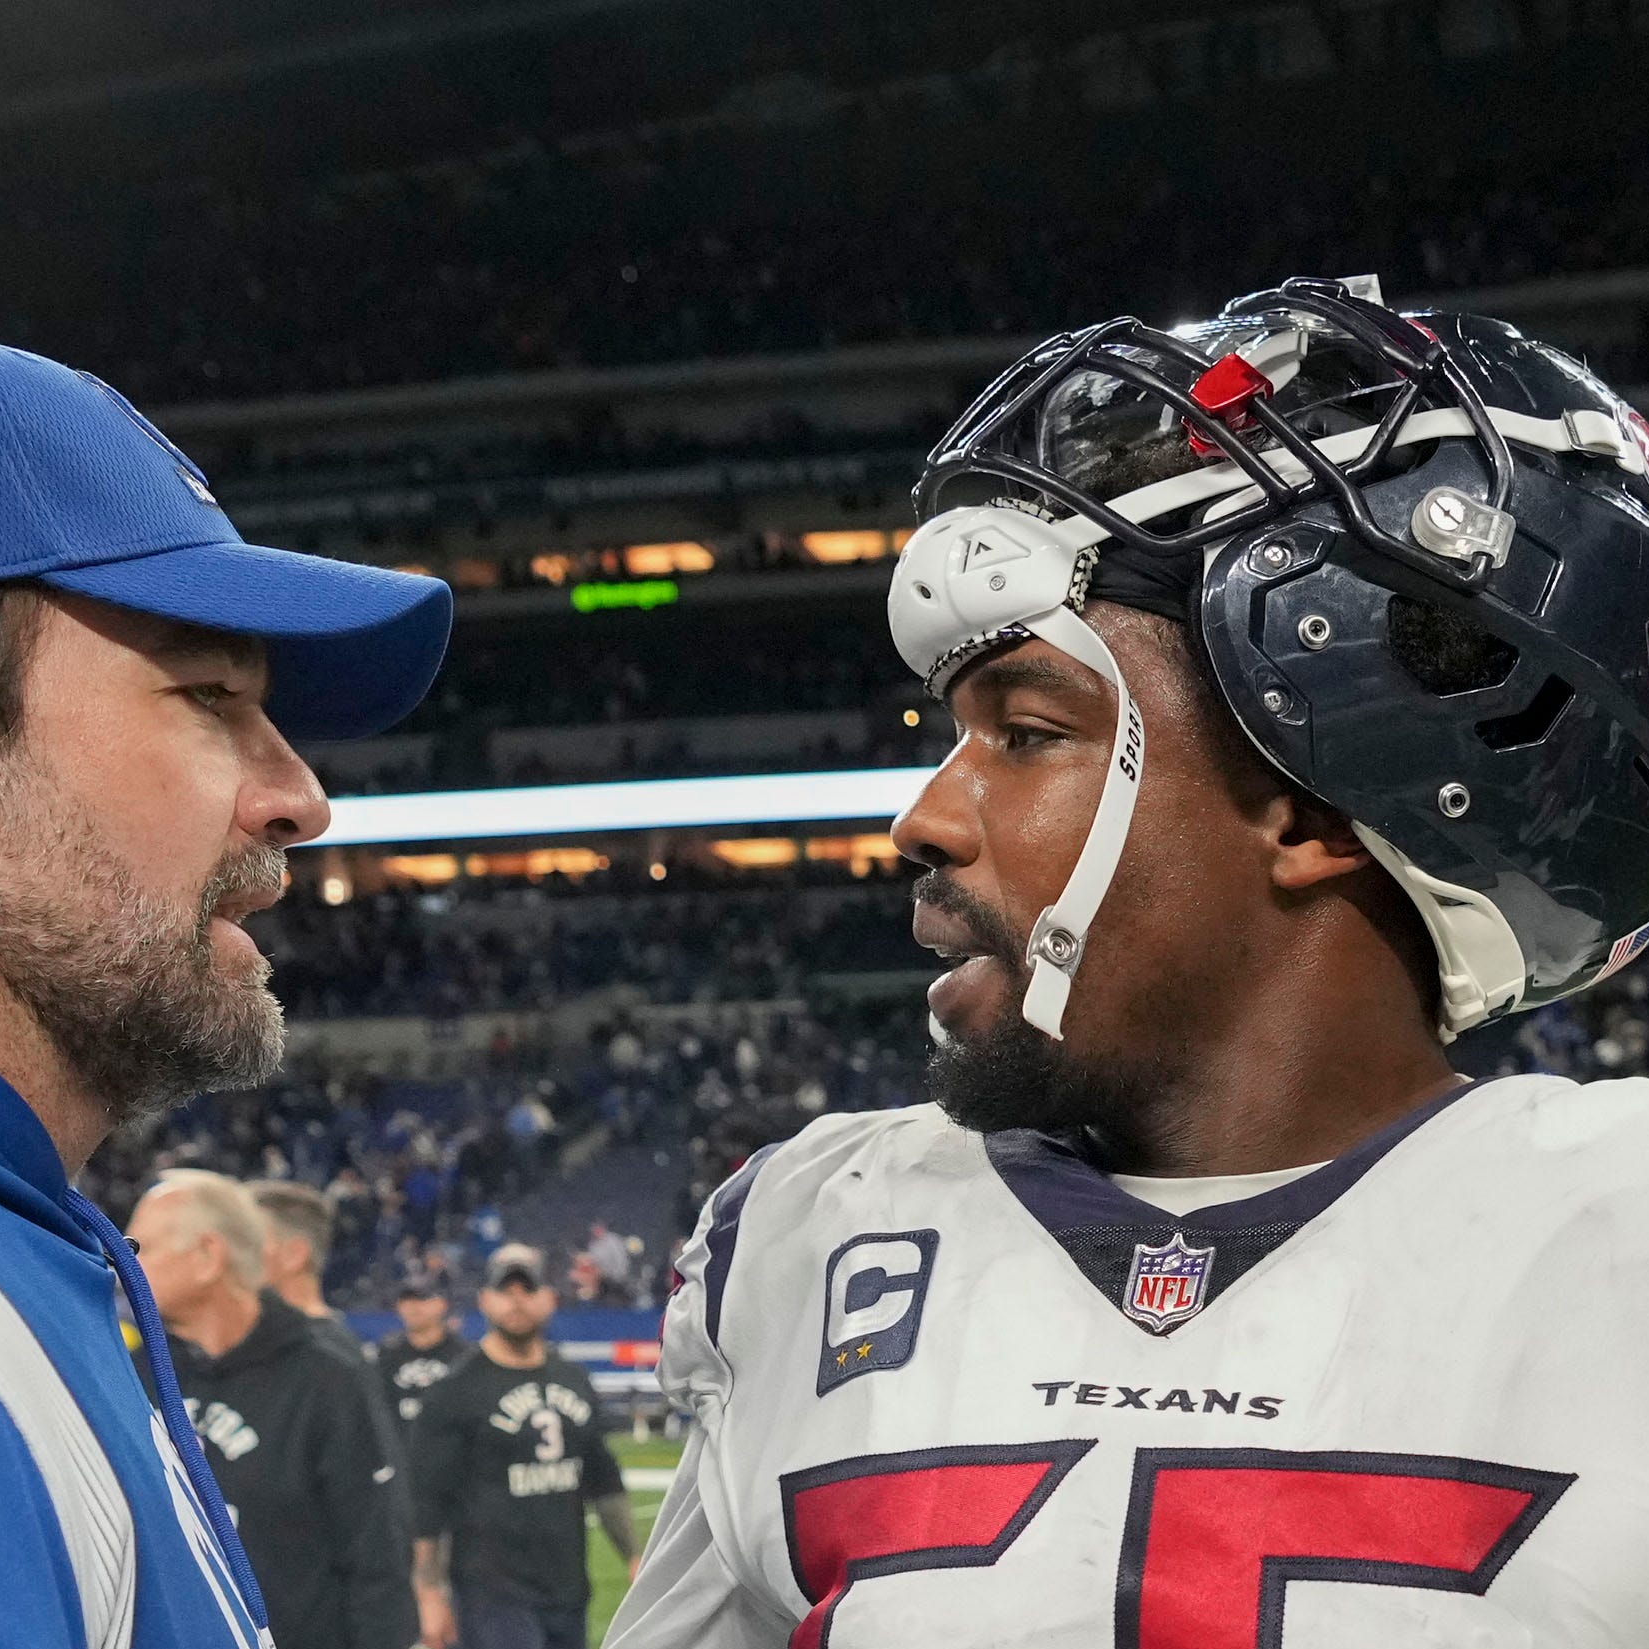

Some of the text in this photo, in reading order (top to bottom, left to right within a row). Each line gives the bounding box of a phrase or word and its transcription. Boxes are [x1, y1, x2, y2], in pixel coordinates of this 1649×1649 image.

[827, 1238, 923, 1348] C
[1136, 1275, 1195, 1313] NFL
[1033, 1381, 1285, 1420] TEXANS
[530, 1408, 565, 1462] 3
